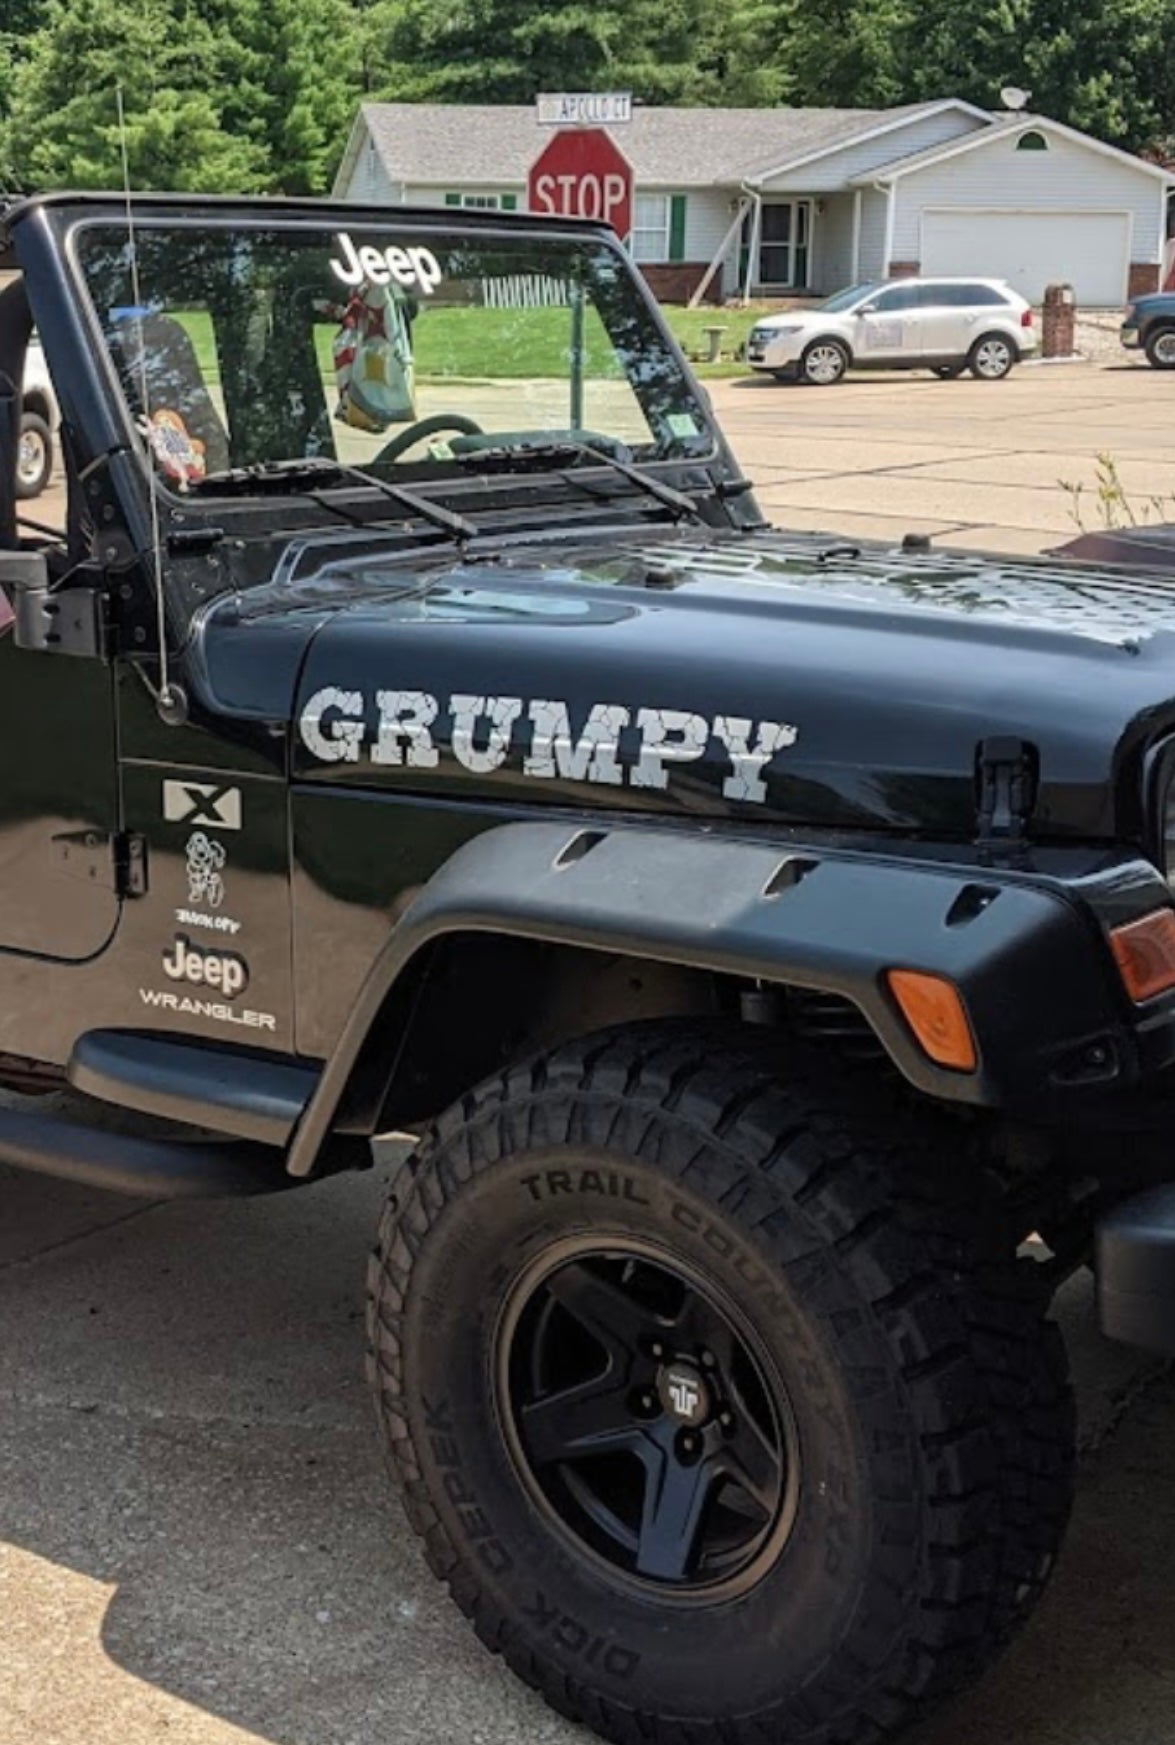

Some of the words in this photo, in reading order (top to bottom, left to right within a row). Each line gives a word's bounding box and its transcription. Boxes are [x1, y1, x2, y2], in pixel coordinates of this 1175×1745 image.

[535, 173, 626, 221] STOP
[329, 232, 442, 295] Jeep
[300, 685, 798, 803] GRUMPY
[162, 938, 247, 999] Jeep
[139, 988, 277, 1032] WRANGLER
[520, 1168, 651, 1205] TRAIL
[522, 1589, 643, 1681] DICK
